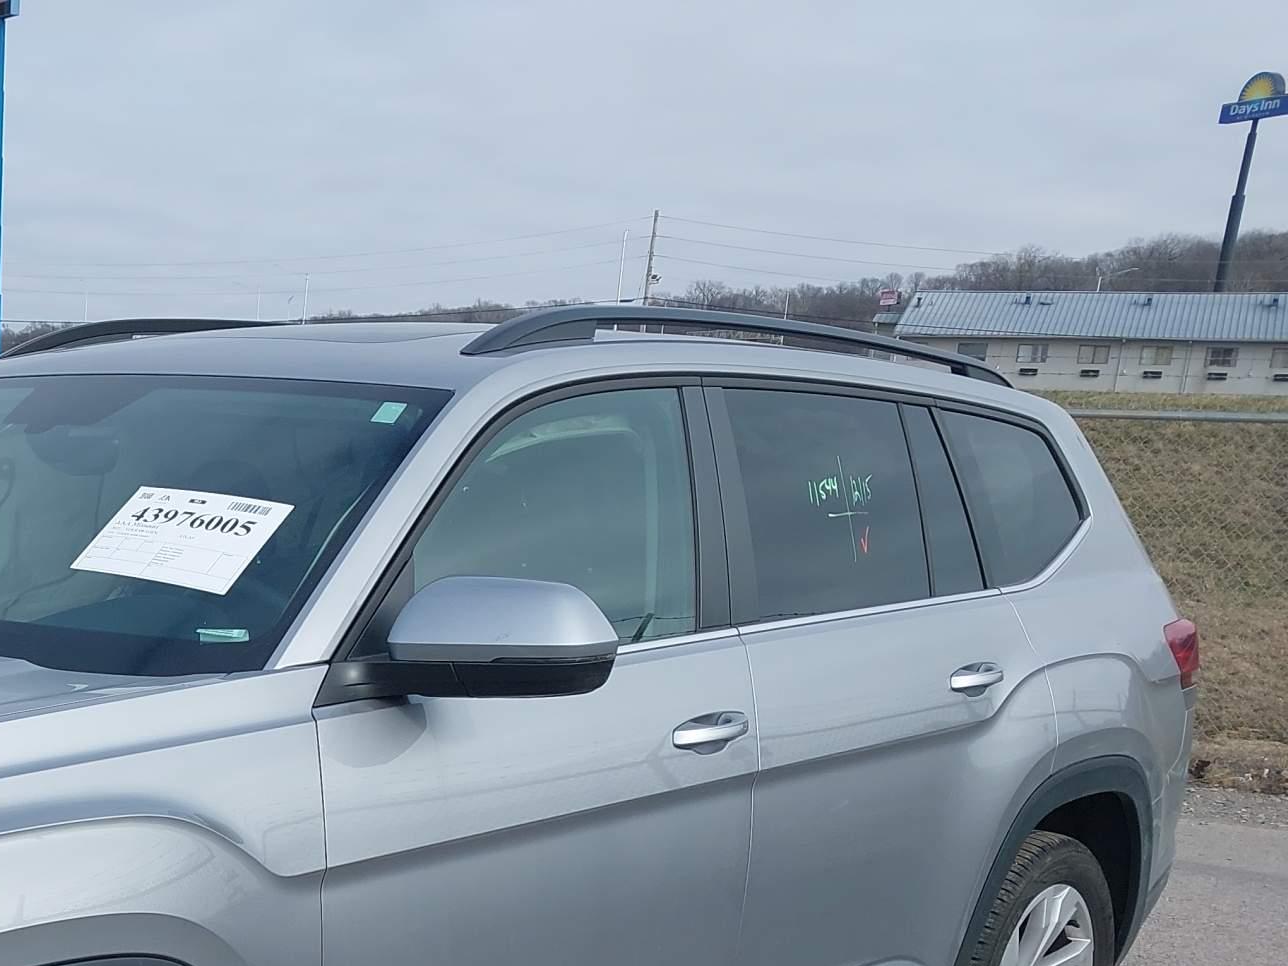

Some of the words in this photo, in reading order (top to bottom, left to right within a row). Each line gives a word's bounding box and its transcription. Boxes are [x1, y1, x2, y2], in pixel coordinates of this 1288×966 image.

[1230, 102, 1260, 115] Days
[1260, 99, 1280, 111] Inn
[131, 506, 258, 537] 43976005
